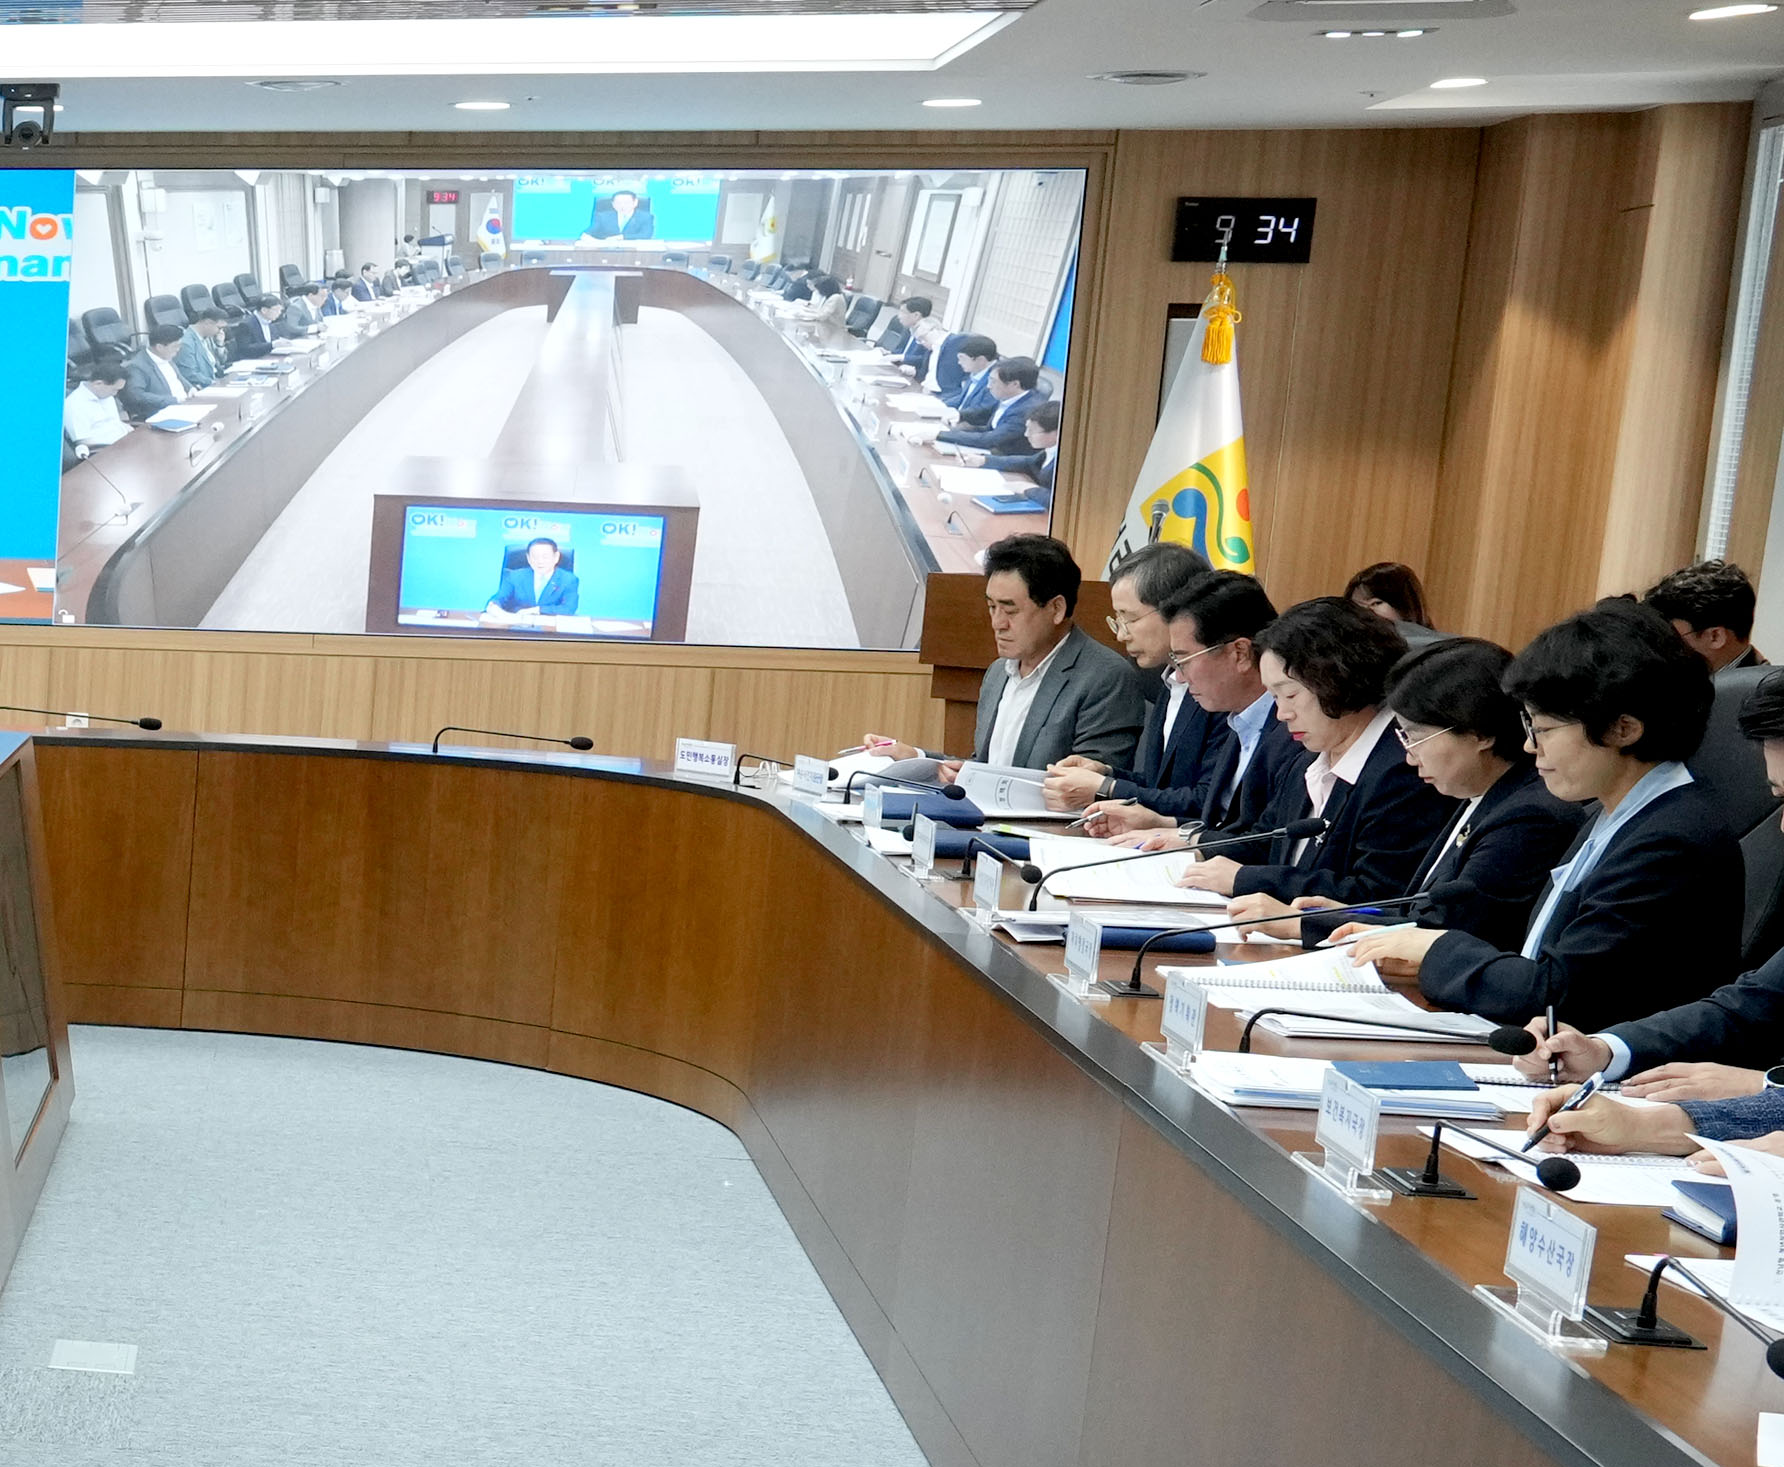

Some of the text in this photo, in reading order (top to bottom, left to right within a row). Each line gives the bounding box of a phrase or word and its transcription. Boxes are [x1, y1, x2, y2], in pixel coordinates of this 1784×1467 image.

[1254, 215, 1299, 244] 34
[679, 750, 729, 767] 도민행복소통실장
[1519, 1220, 1574, 1278] 해양수산국장
